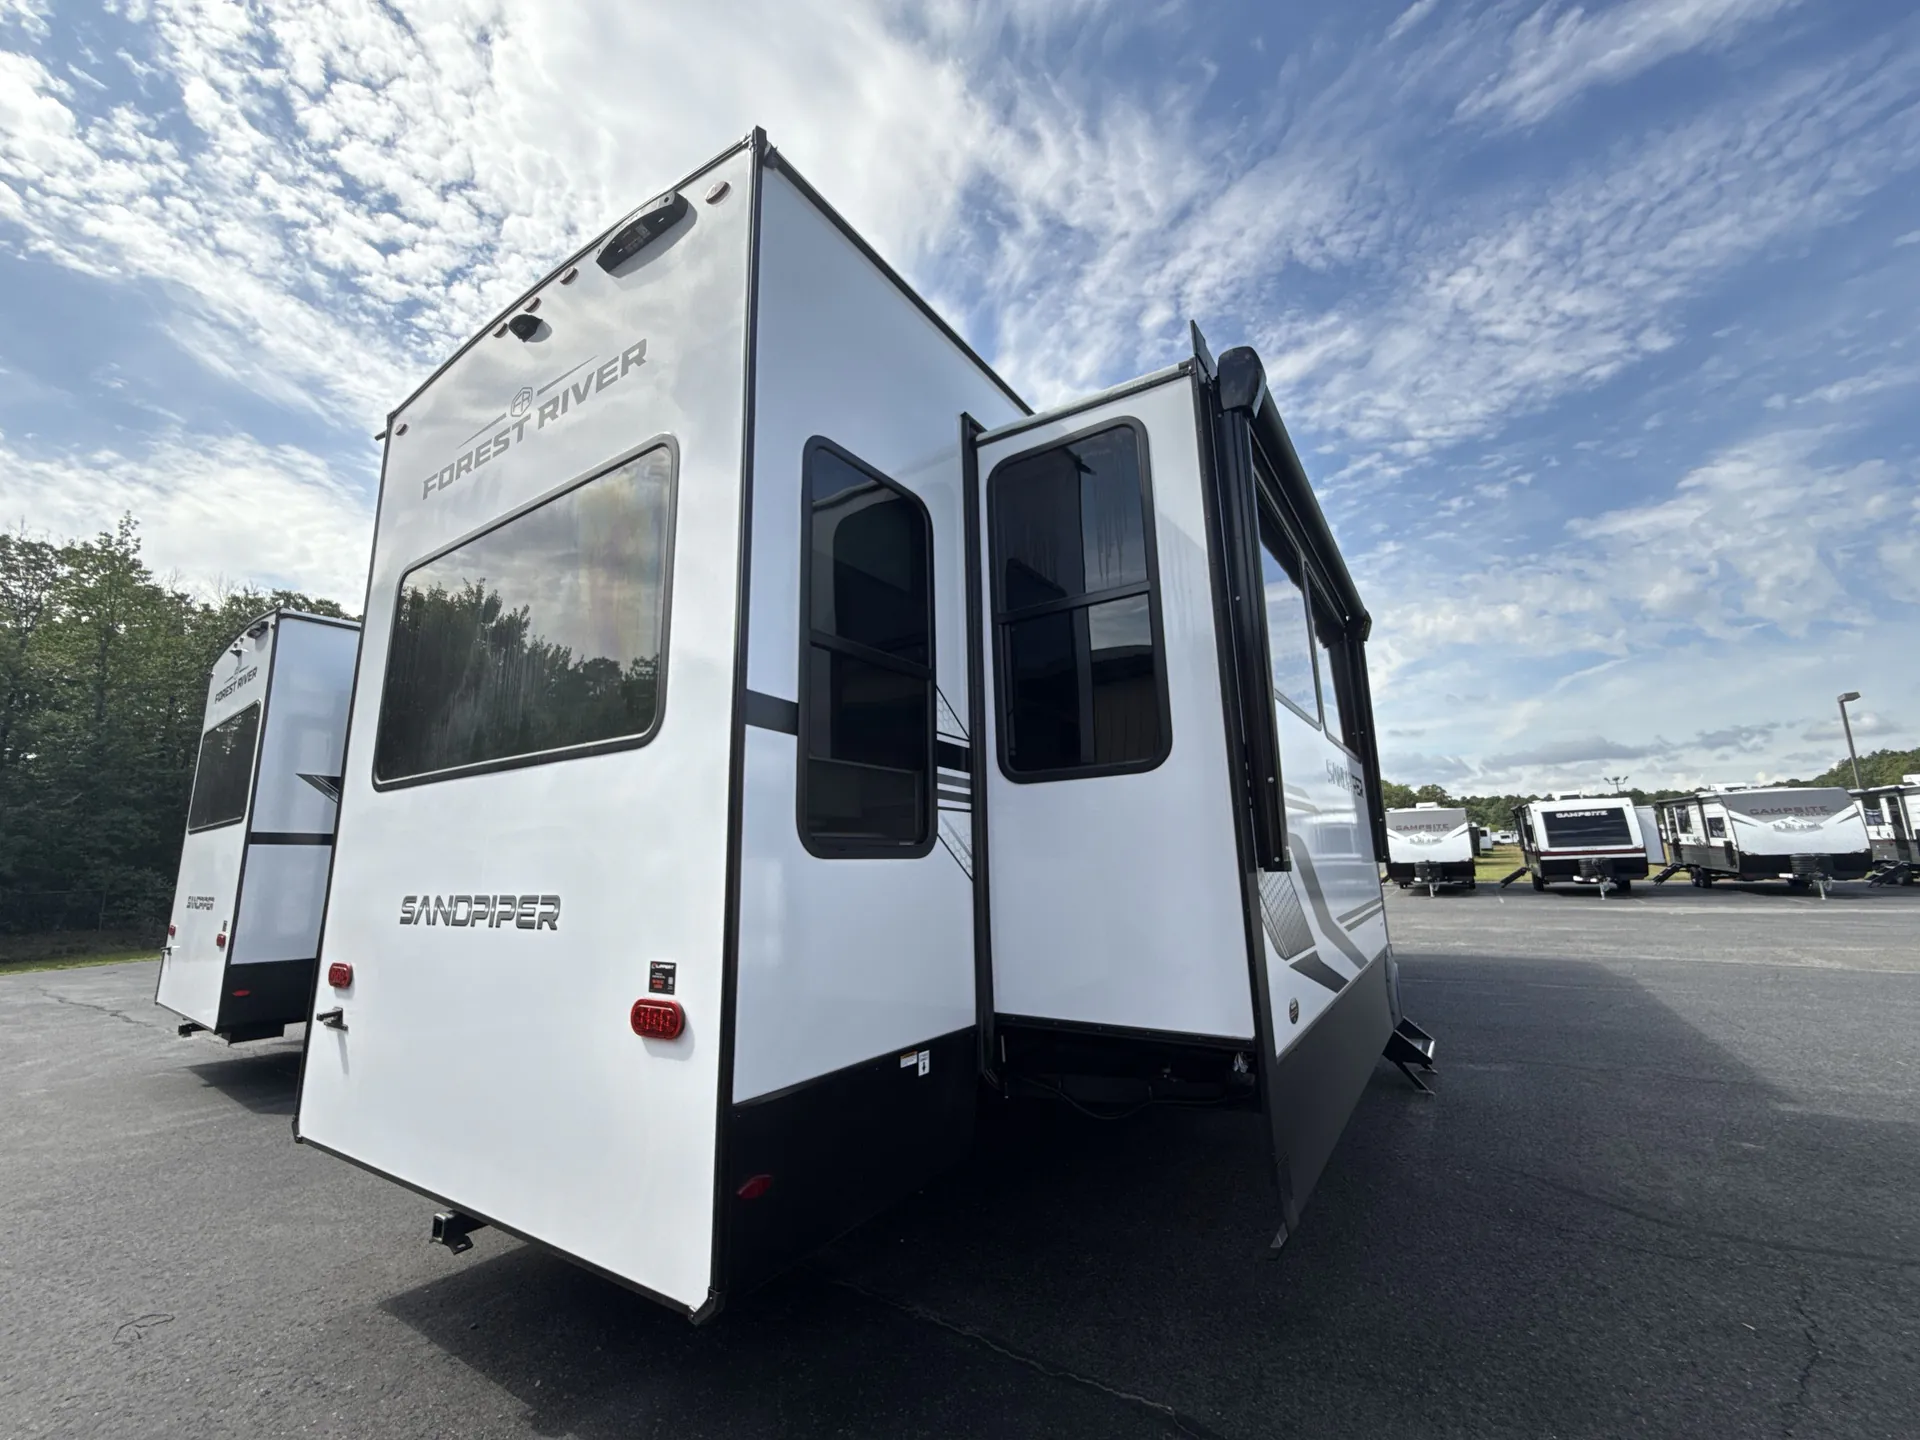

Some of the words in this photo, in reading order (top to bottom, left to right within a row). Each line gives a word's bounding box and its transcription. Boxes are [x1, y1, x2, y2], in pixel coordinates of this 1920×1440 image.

[422, 412, 531, 500] FOREST
[537, 338, 648, 430] RIVER
[214, 680, 238, 705] FOREST
[237, 666, 258, 690] RIVER
[1555, 810, 1608, 819] CAMPSITE
[1749, 805, 1829, 816] CAMPSITE
[1395, 823, 1450, 832] CAMPSITE
[399, 894, 561, 931] SANDPIPER
